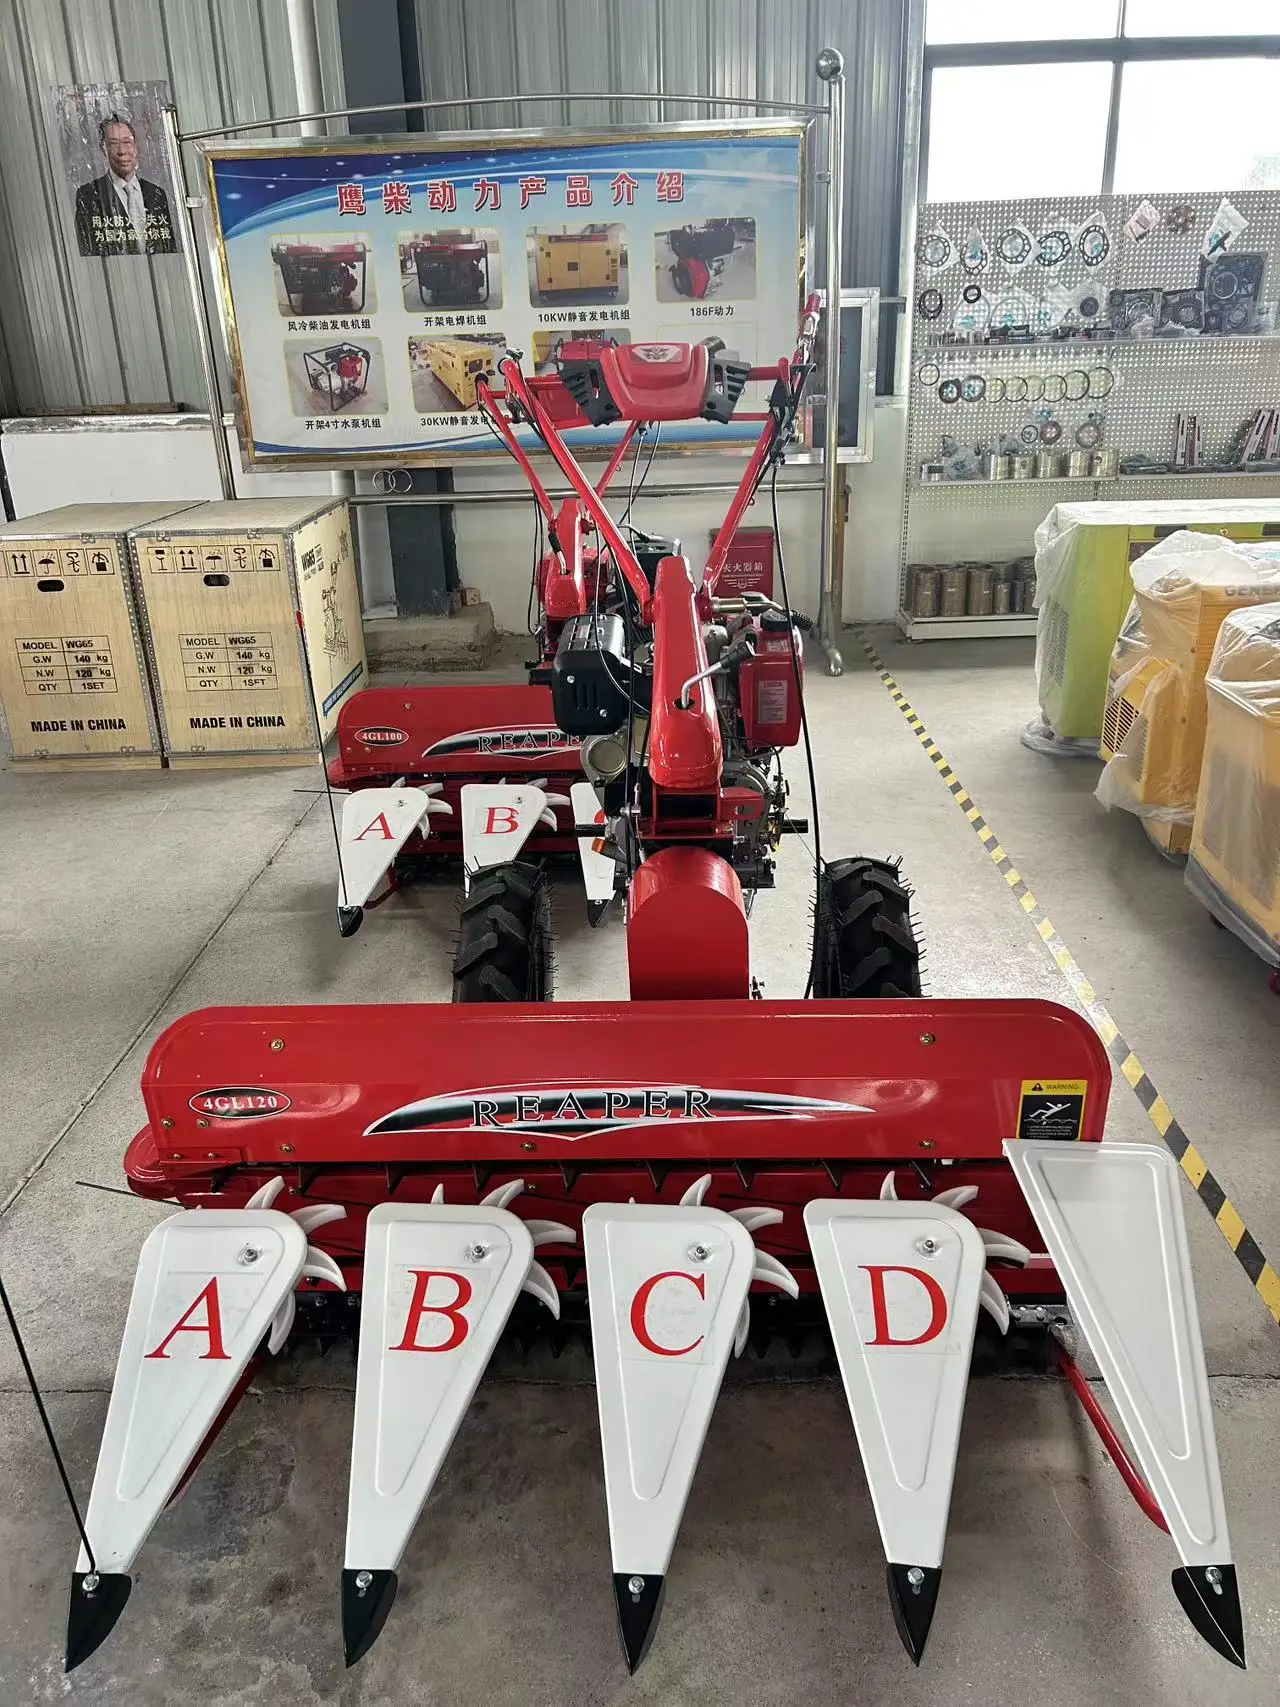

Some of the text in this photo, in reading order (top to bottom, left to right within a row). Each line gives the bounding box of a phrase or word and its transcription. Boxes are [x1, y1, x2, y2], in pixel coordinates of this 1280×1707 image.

[337, 171, 684, 215] 鹰柴动力产品介绍
[538, 308, 631, 323] 10KW静音发电机组
[690, 305, 734, 317] 186F动力
[287, 318, 372, 331] 风冷柴油发电机组
[423, 314, 487, 327] 开架电焊机组
[305, 418, 382, 430] 开架4寸水泵机组
[420, 414, 497, 427] 30KW静音发电
[22, 639, 93, 650] MODEL WG65
[185, 635, 257, 646] MODEL WG65
[32, 653, 109, 664] G.W 140 kg
[195, 650, 271, 660] G.W 140 kg
[36, 667, 112, 678] N.W 120 kg
[197, 664, 273, 674] N.W 120 kg
[38, 681, 105, 692] QTY 1SET
[199, 679, 219, 688] QTY
[31, 718, 127, 732] MADE IN CHINA
[189, 715, 286, 728] MADE IN CHINA
[361, 732, 403, 742] 4GL100
[353, 811, 397, 841] A
[483, 806, 520, 835] B
[203, 1095, 279, 1111] 4GL120
[469, 1088, 716, 1128] REAPER
[388, 1269, 473, 1352] B
[857, 1264, 948, 1346] D
[144, 1275, 232, 1360] A
[630, 1270, 705, 1357] C
